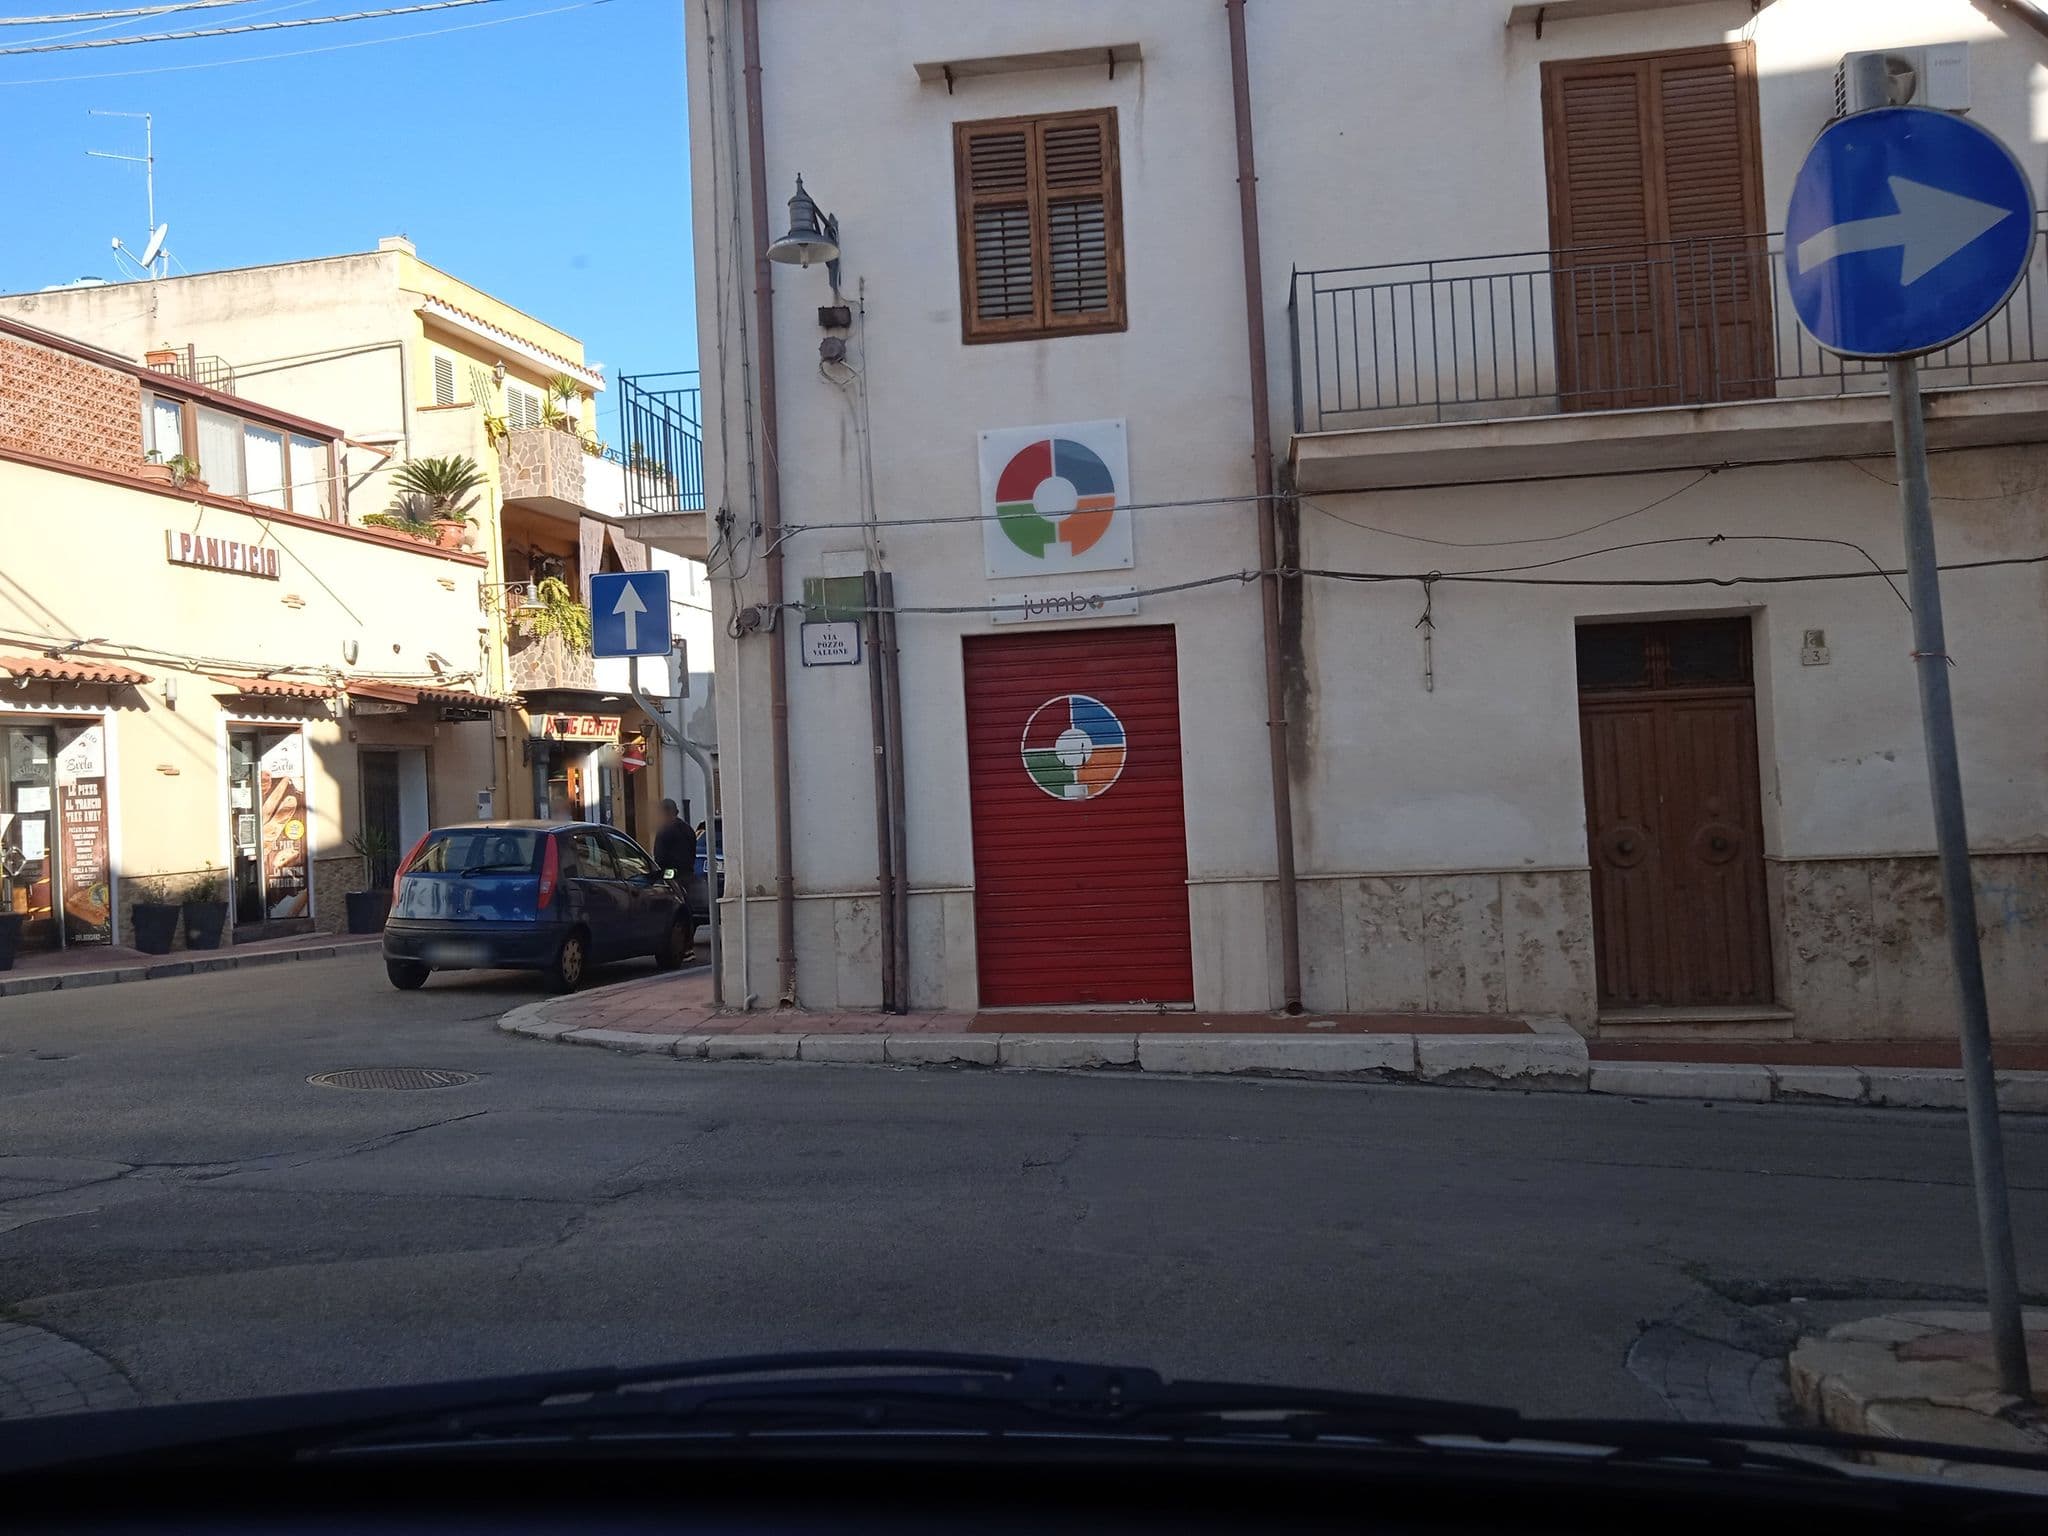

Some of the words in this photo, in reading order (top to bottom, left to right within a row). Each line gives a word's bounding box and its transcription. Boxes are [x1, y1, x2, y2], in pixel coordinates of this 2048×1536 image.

[180, 532, 277, 576] PANIFICIO
[1024, 592, 1104, 620] jumbo
[817, 641, 844, 649] POZZO
[1812, 650, 1821, 662] 3
[581, 718, 618, 736] CENTER
